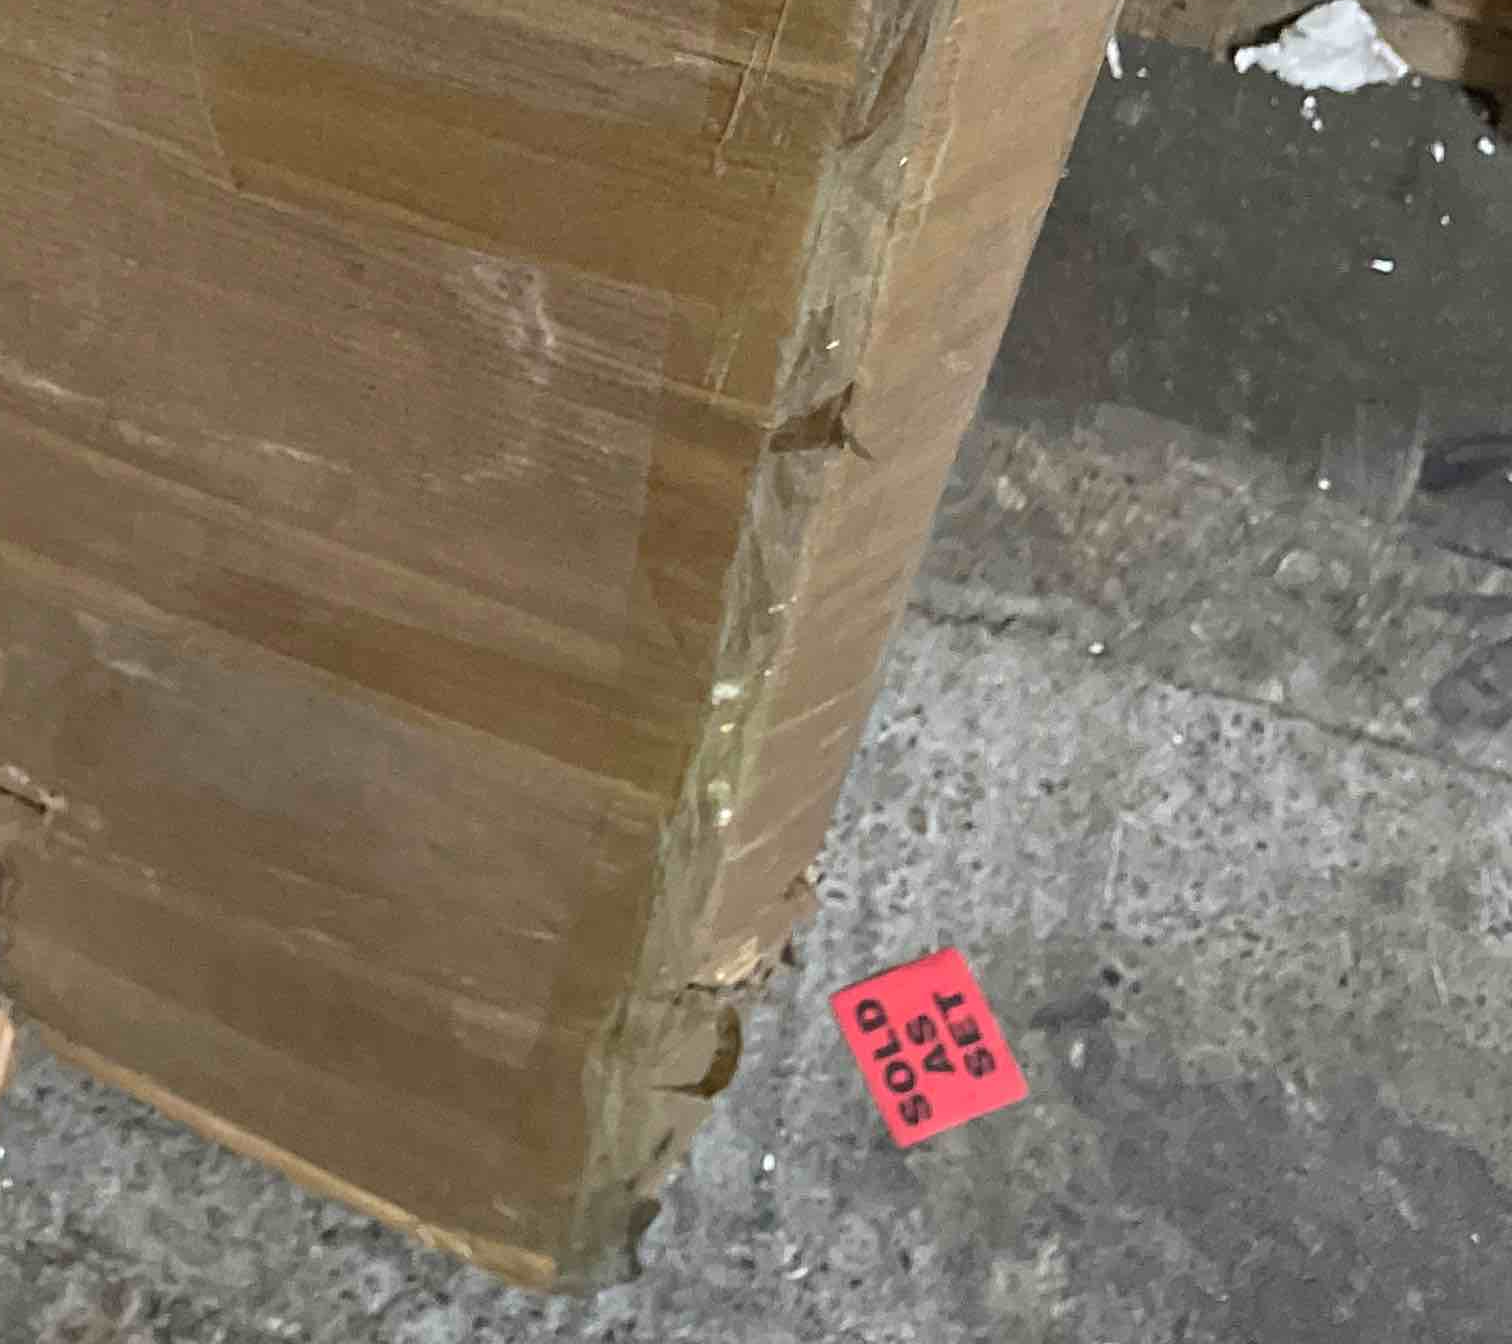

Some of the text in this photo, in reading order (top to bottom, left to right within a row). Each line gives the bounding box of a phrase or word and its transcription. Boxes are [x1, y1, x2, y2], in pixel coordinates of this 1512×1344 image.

[855, 997, 934, 1127] SOLD
[905, 1015, 956, 1074] AS
[932, 991, 997, 1079] SET
